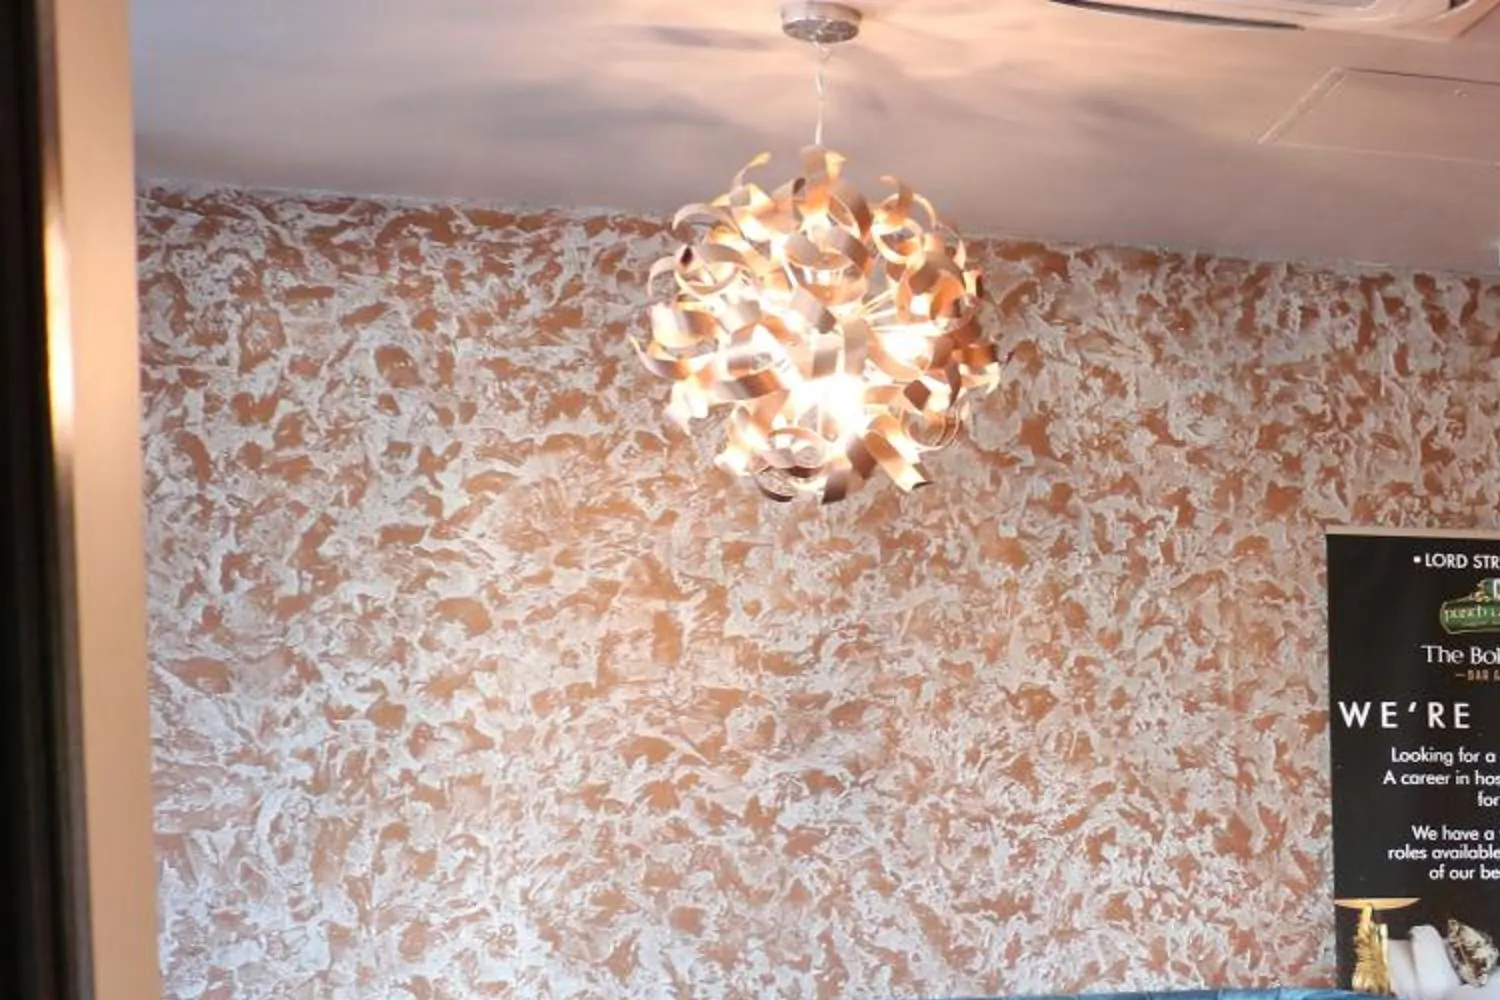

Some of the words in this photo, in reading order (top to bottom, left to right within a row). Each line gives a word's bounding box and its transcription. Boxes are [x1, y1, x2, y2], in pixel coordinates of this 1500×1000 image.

[1425, 553, 1468, 569] LORD
[1420, 645, 1464, 663] The
[1337, 701, 1471, 729] WE'RE
[1391, 747, 1454, 766] Looking
[1459, 747, 1480, 763] for
[1485, 751, 1496, 763] a
[1382, 770, 1397, 785] A
[1401, 773, 1450, 785] career
[1456, 770, 1470, 785] in
[1477, 791, 1500, 807] for
[1411, 825, 1438, 841] We
[1442, 824, 1479, 841] have
[1484, 828, 1495, 841] a
[1388, 844, 1427, 860] roles
[1429, 863, 1446, 880] of
[1449, 867, 1476, 880] our
